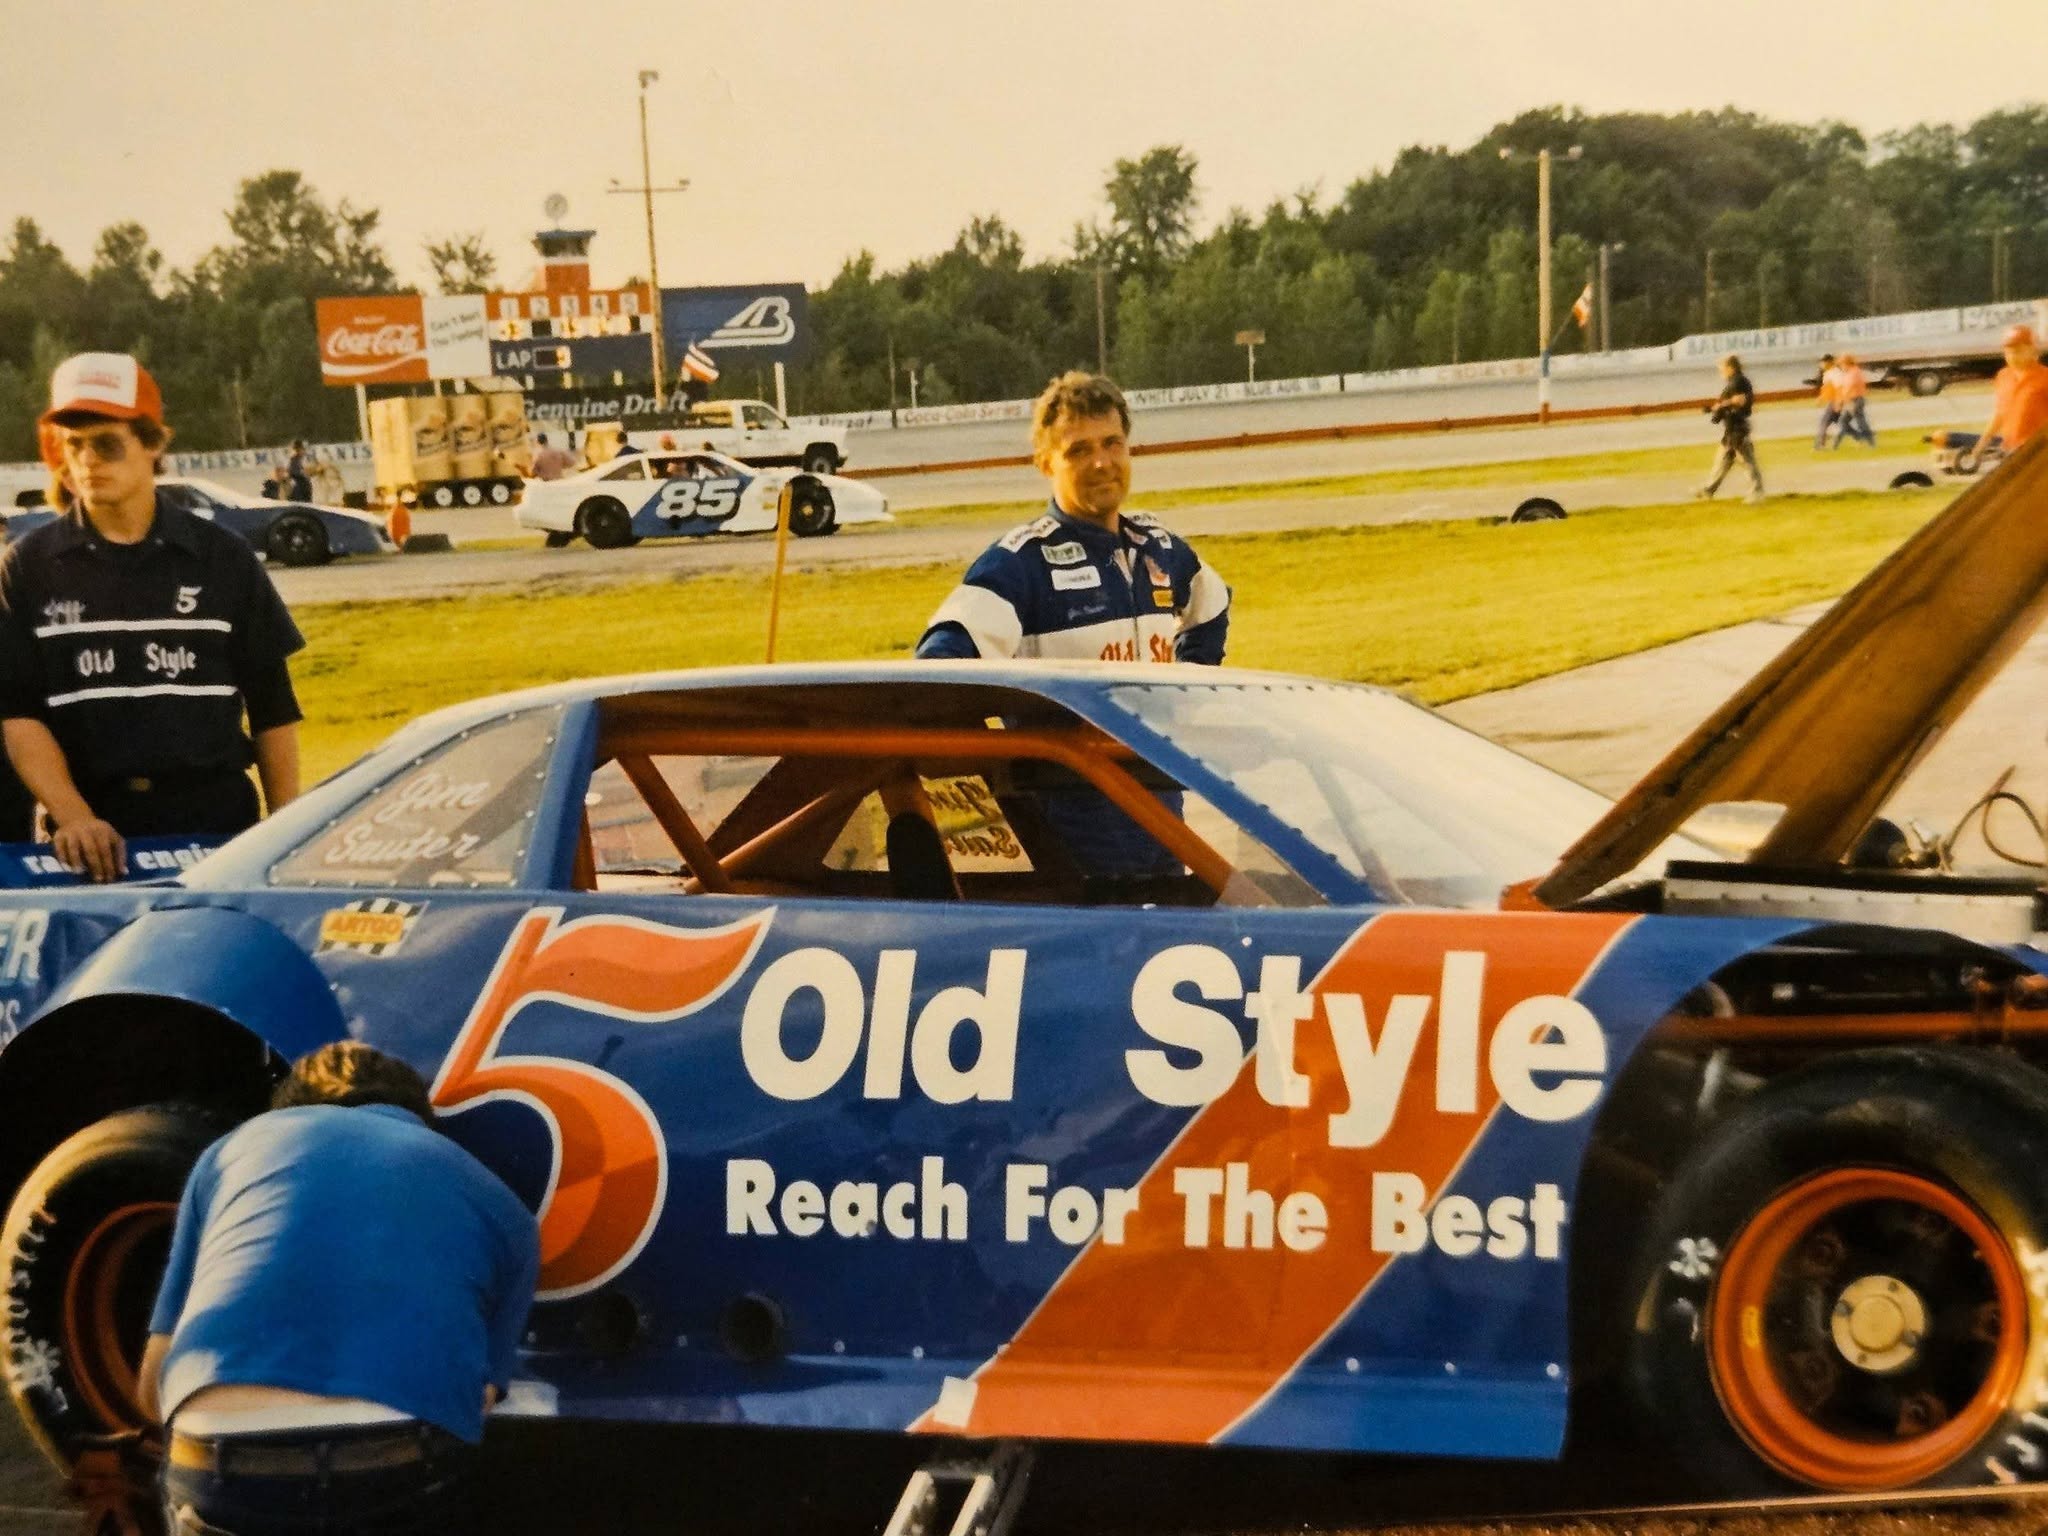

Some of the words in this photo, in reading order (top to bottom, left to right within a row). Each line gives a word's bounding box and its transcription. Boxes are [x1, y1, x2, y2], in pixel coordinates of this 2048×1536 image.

[327, 322, 419, 358] Coca-Cola
[496, 350, 532, 369] LAP
[655, 478, 741, 520] 85
[175, 586, 203, 614] 5
[78, 648, 116, 678] Old
[146, 641, 198, 679] Style
[741, 947, 1027, 1105] Old
[1125, 943, 1607, 1149] Style
[428, 905, 778, 1300] 5
[726, 1156, 969, 1241] Reach
[1005, 1162, 1140, 1246] For
[1173, 1162, 1329, 1252] The
[1371, 1171, 1566, 1260] Best
